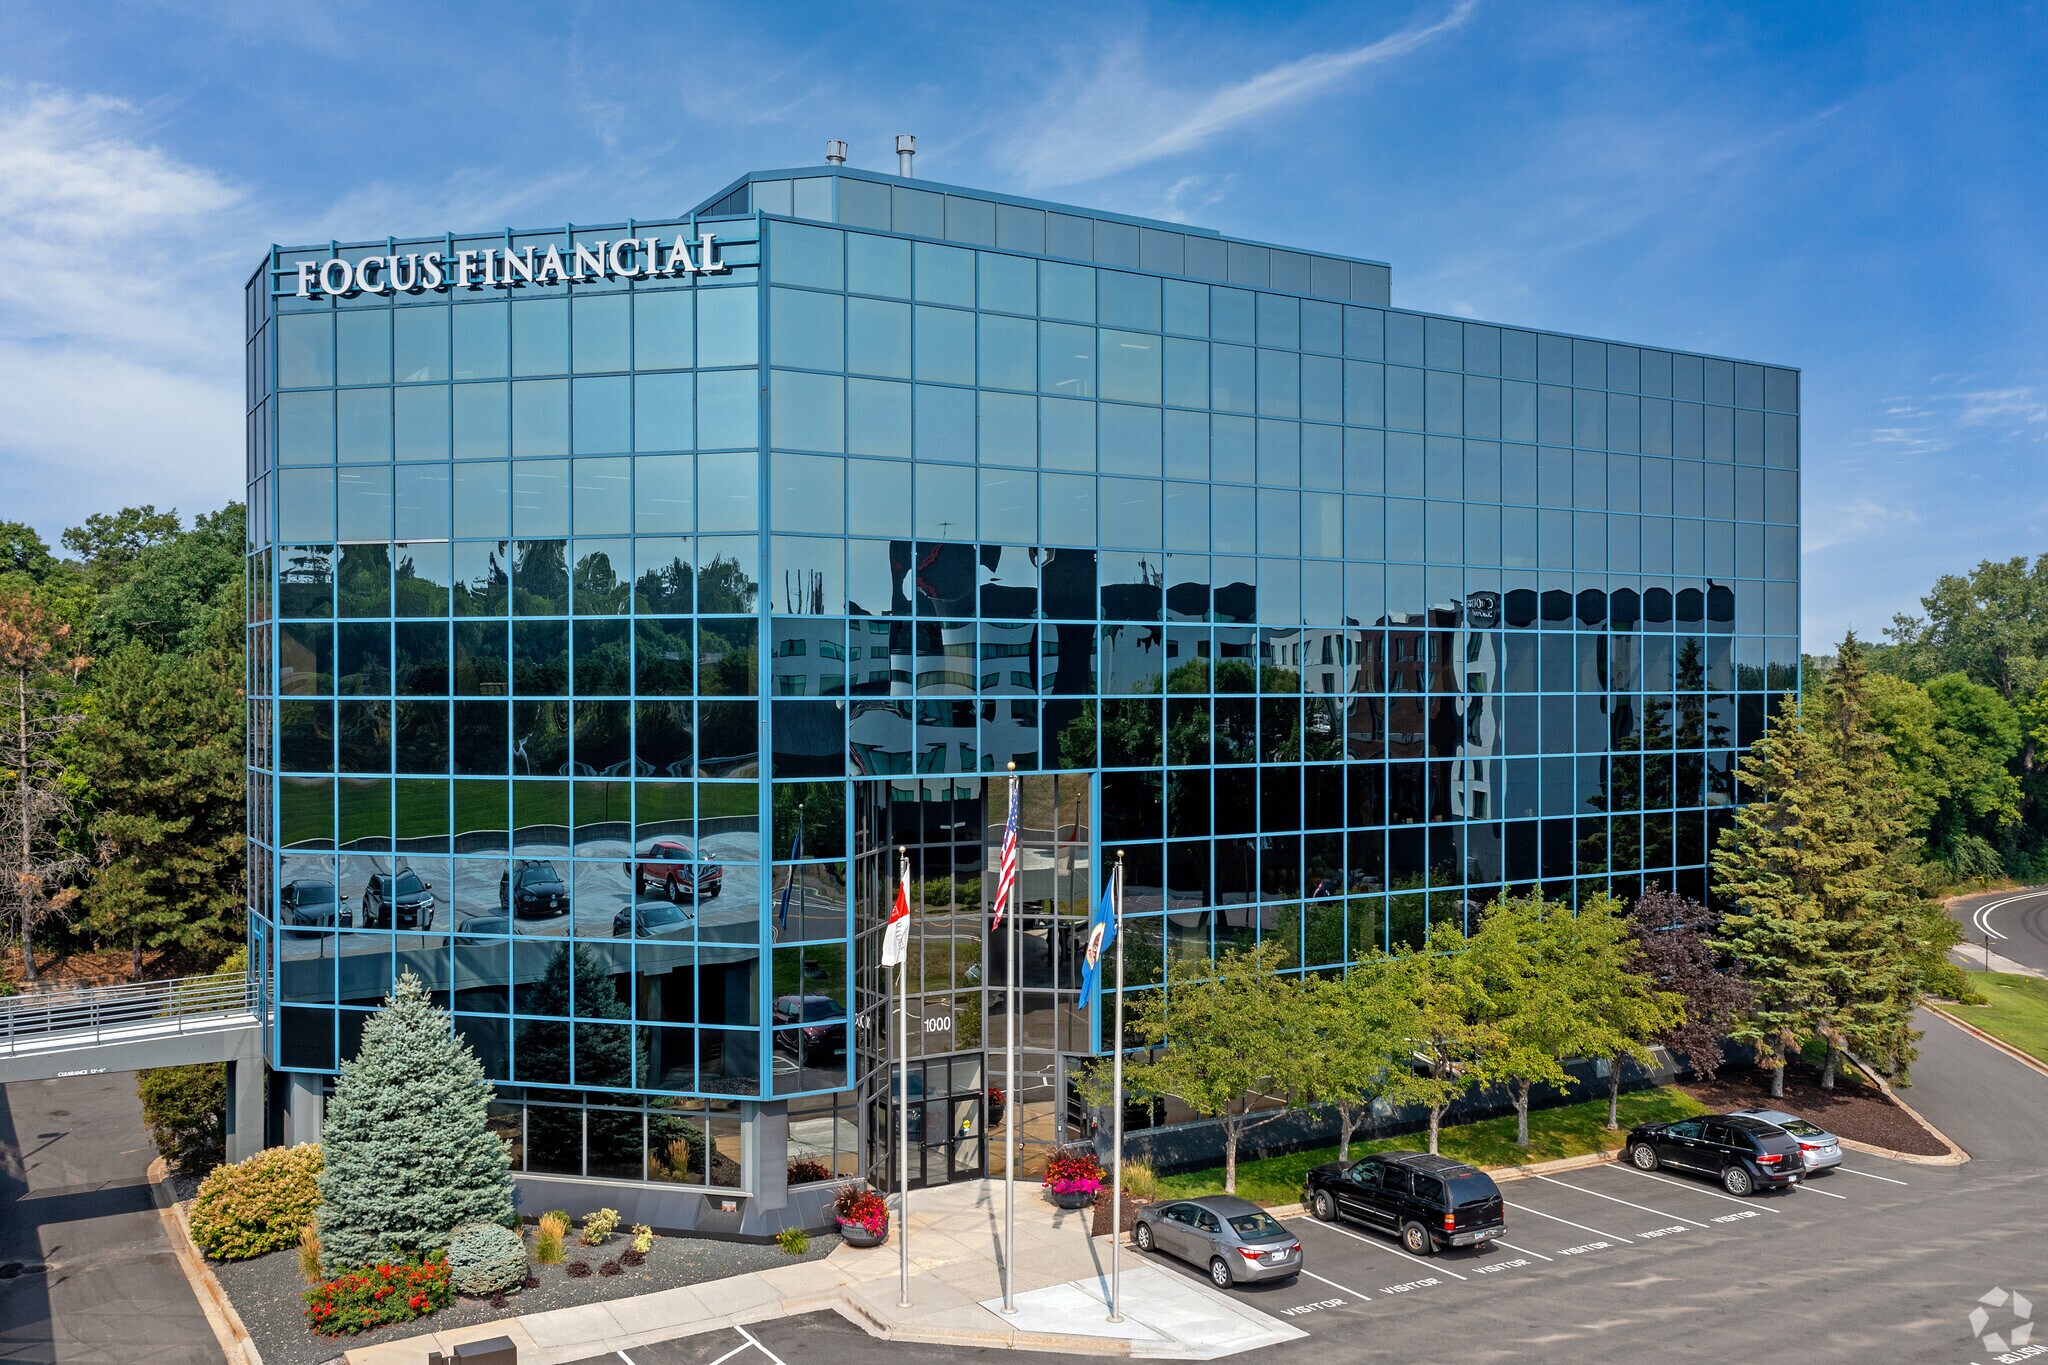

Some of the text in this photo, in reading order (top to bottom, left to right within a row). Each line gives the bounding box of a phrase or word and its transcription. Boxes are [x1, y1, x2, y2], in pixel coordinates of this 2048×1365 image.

[295, 233, 724, 297] FOCUS FINANCIAL
[924, 1016, 951, 1032] 1000
[57, 1069, 88, 1078] CLEARANCE
[1710, 1210, 1761, 1223] VISITOR
[1636, 1225, 1690, 1239] VISITOR
[1557, 1241, 1614, 1256] VISITOR
[1472, 1258, 1532, 1274] VISITOR
[1379, 1277, 1443, 1295] VISITOR
[1280, 1298, 1348, 1317] VISITOR
